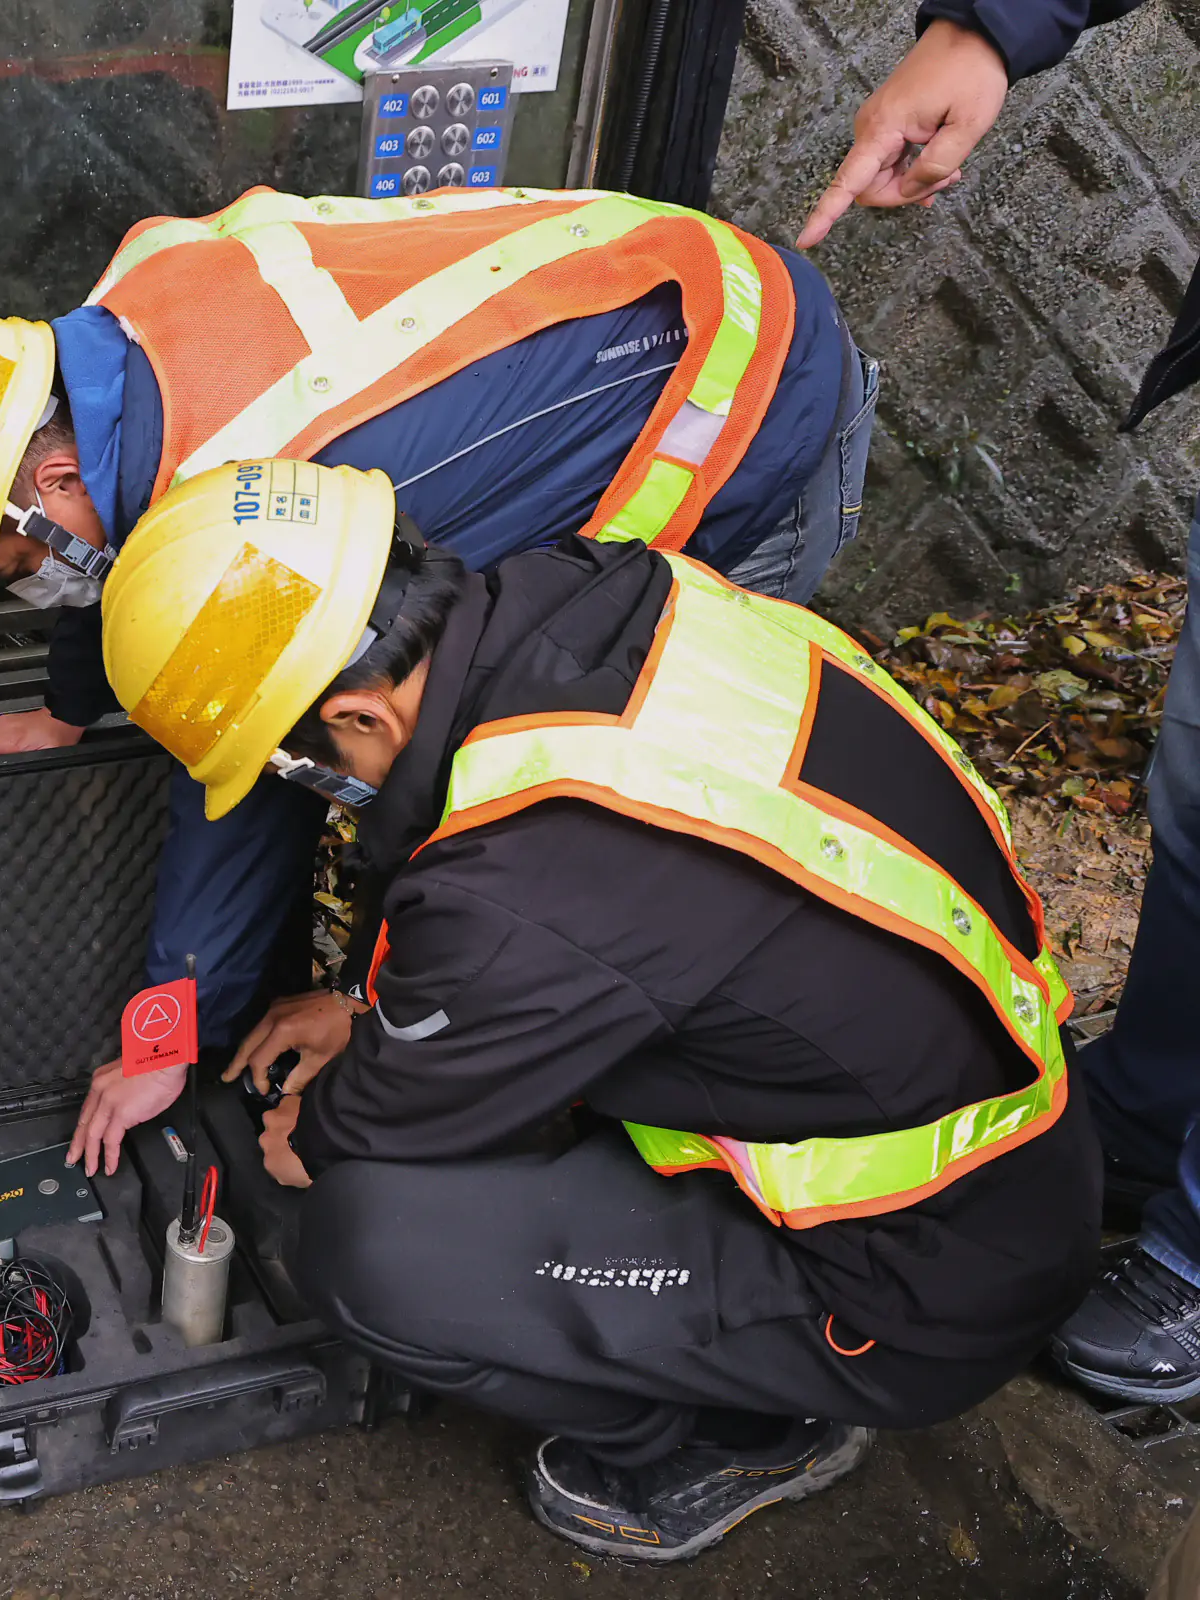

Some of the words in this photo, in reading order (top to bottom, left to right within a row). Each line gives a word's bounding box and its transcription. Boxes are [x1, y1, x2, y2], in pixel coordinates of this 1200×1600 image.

[481, 93, 500, 105] 601
[383, 100, 403, 112] 402
[476, 132, 495, 144] 602
[379, 139, 399, 152] 403
[471, 171, 490, 183] 603
[376, 179, 395, 191] 406
[596, 339, 641, 364] SUNRISE
[135, 1049, 179, 1065] GUTERMANN
